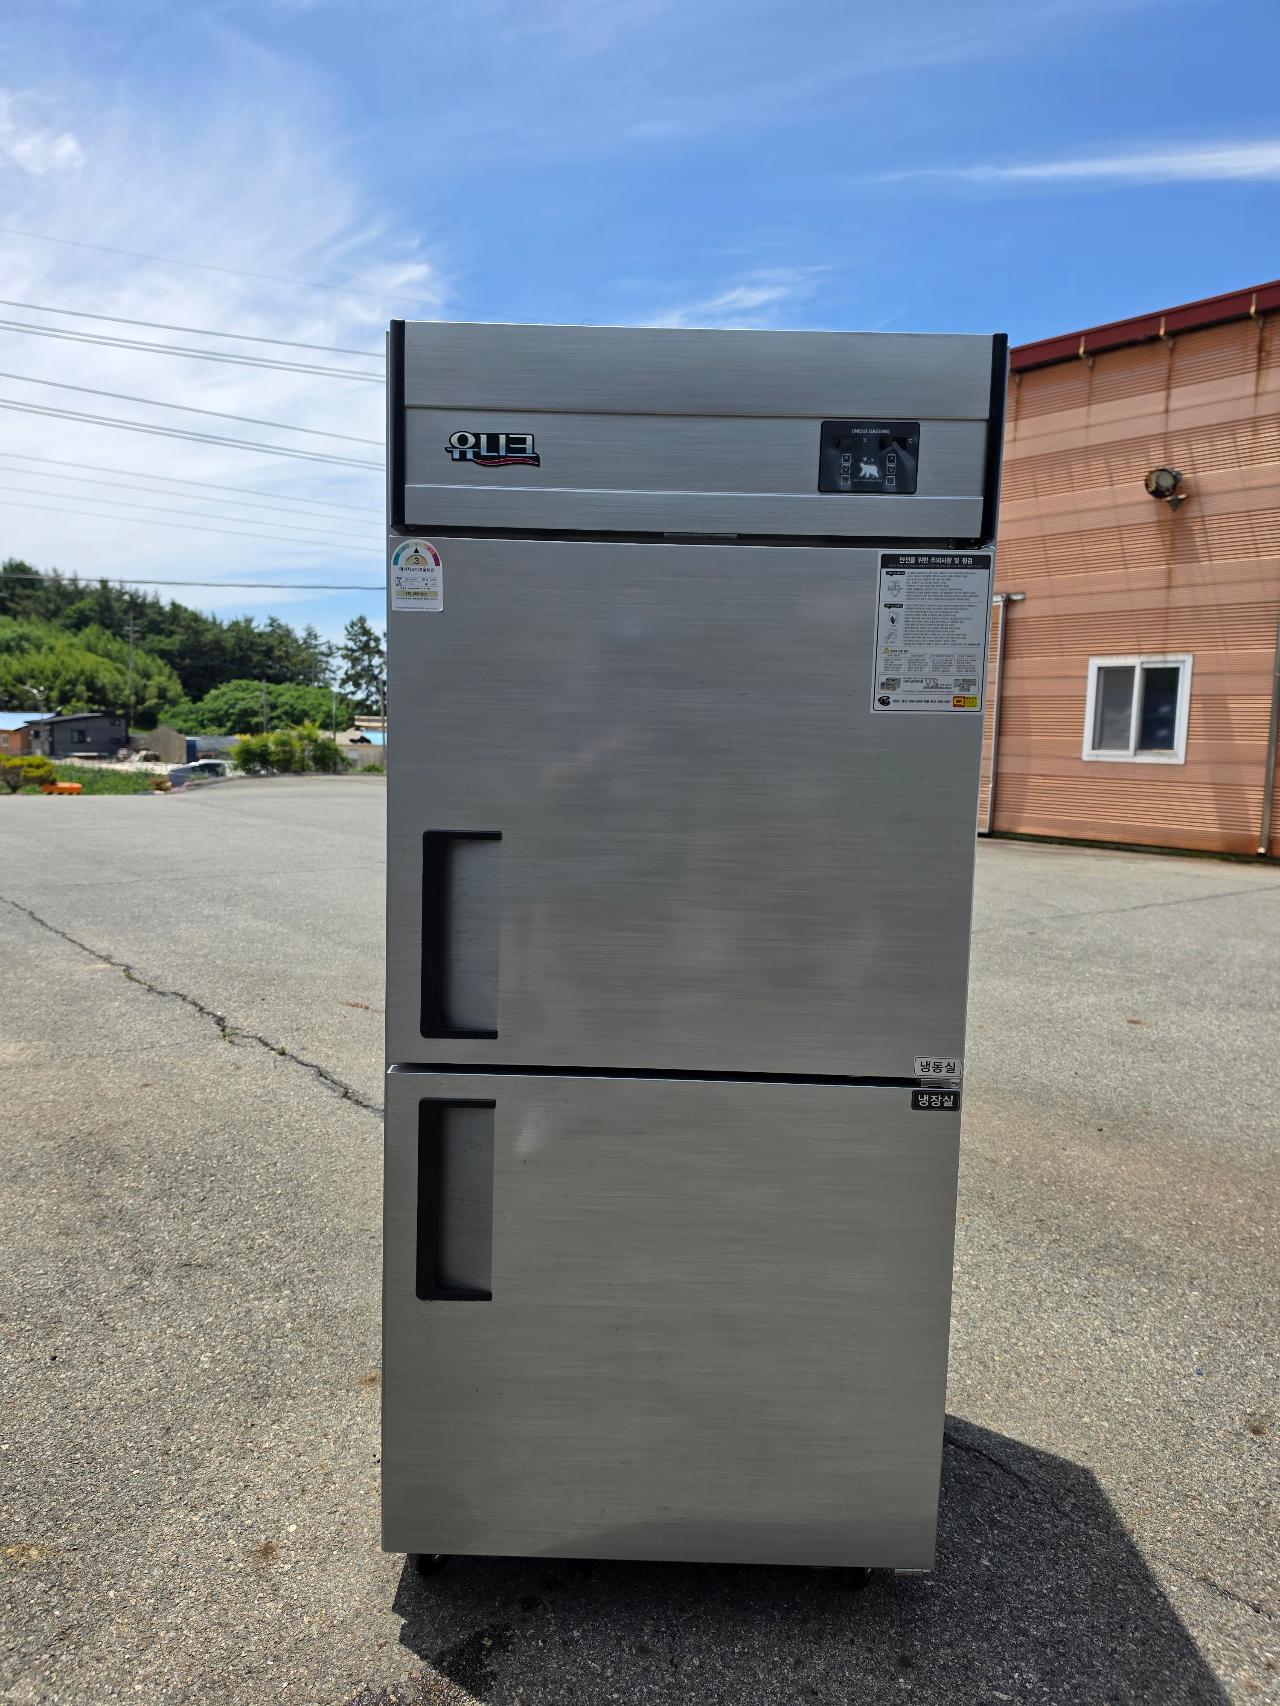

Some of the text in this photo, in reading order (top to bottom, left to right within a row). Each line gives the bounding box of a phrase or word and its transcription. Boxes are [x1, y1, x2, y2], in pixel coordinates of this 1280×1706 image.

[445, 431, 539, 462] 유니크
[413, 556, 420, 565] 3
[899, 556, 973, 565] 안전을 위한 주의사항 및 점검
[920, 1060, 956, 1074] 냉동실
[918, 1094, 954, 1107] 냉장실
